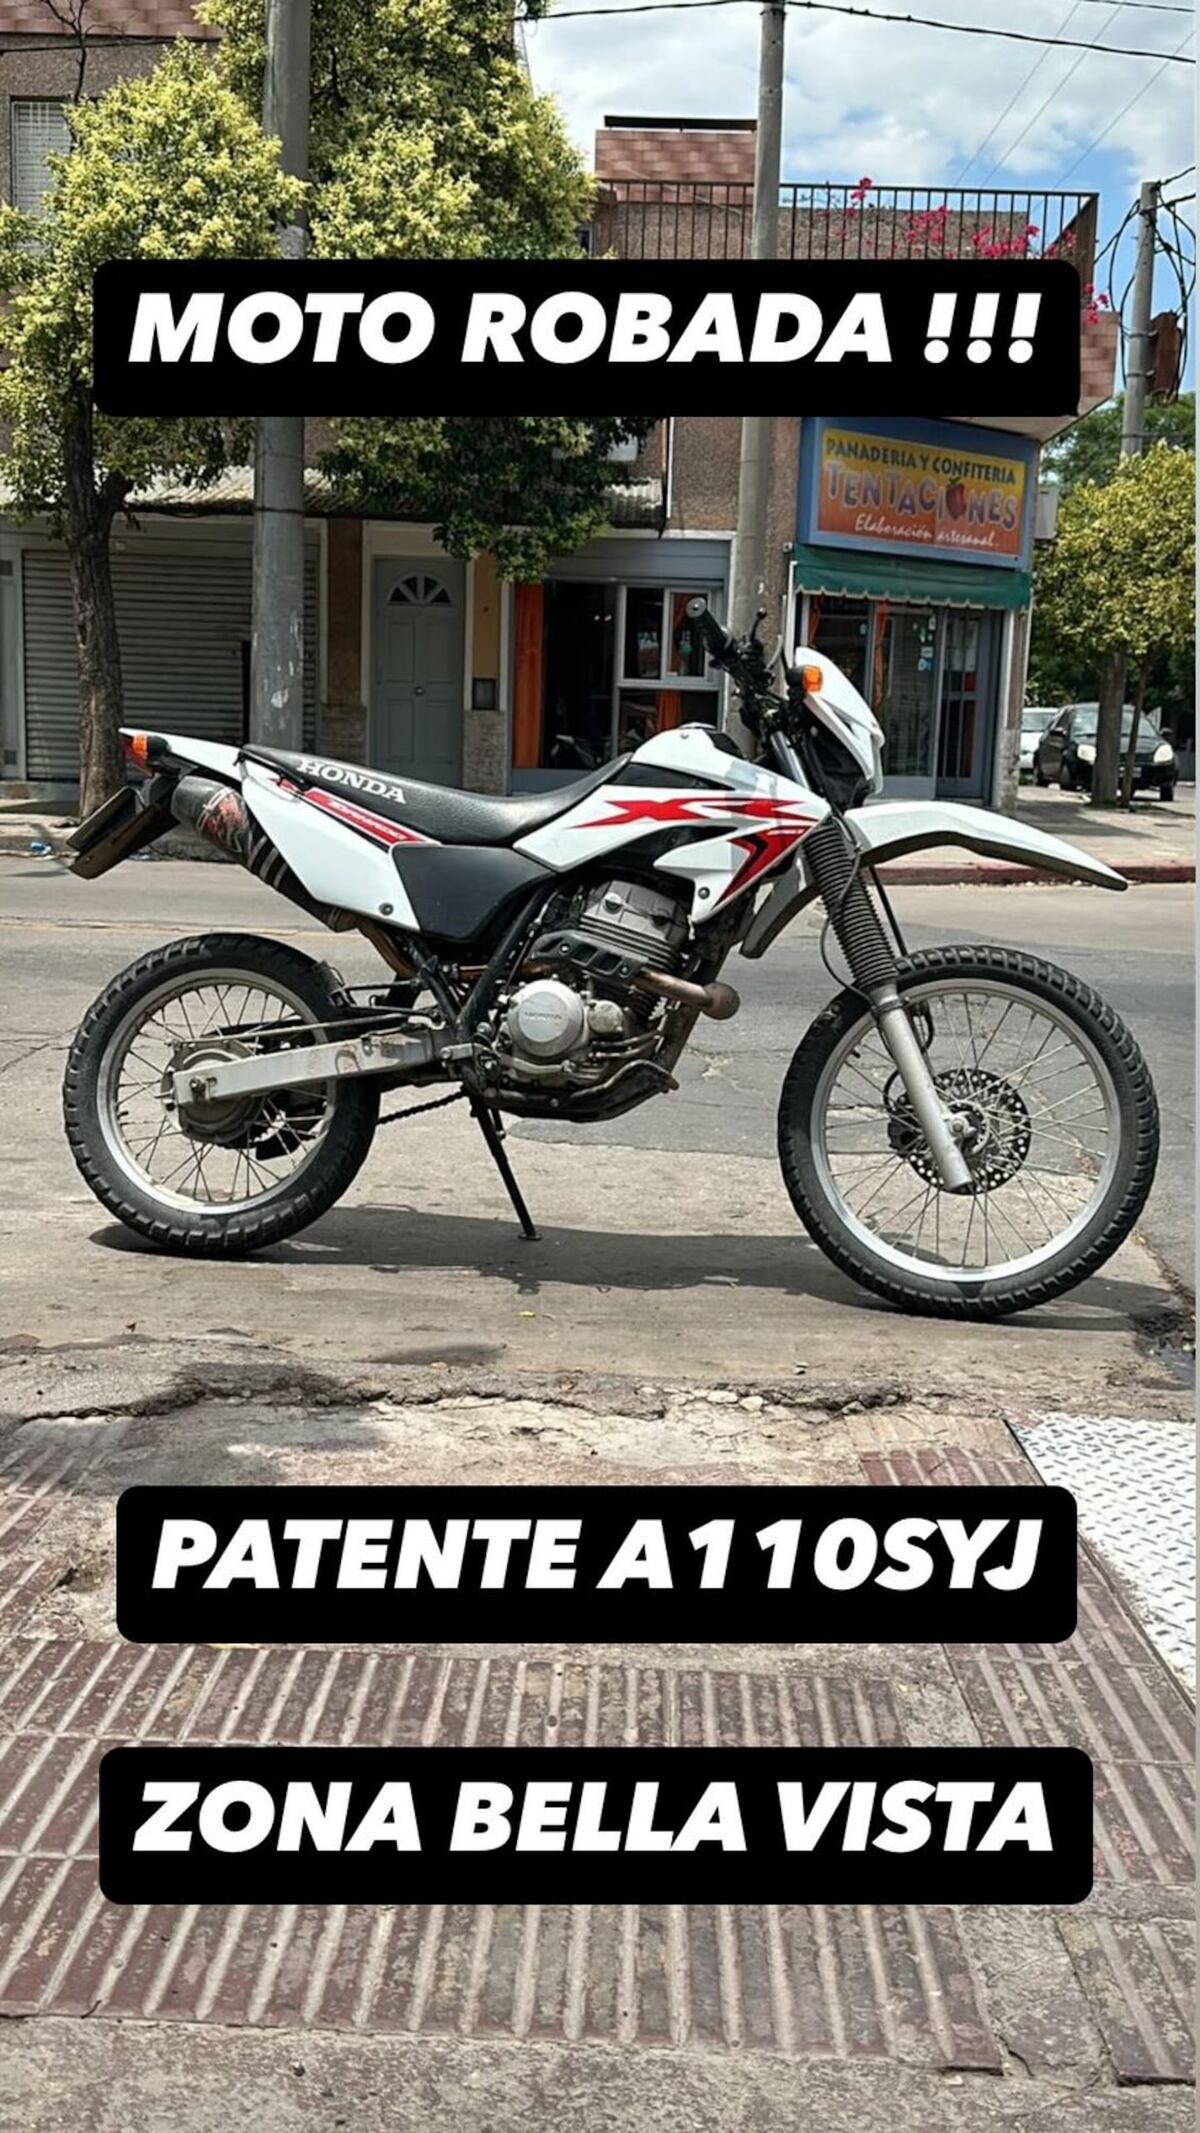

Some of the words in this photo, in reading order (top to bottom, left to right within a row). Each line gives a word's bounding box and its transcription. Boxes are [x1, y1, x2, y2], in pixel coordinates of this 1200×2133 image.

[826, 438, 916, 468] PANADERIA
[920, 454, 931, 471] Y
[932, 457, 1017, 485] CONFITERIA
[855, 513, 933, 541] Elaboración
[297, 758, 407, 805] HONDA
